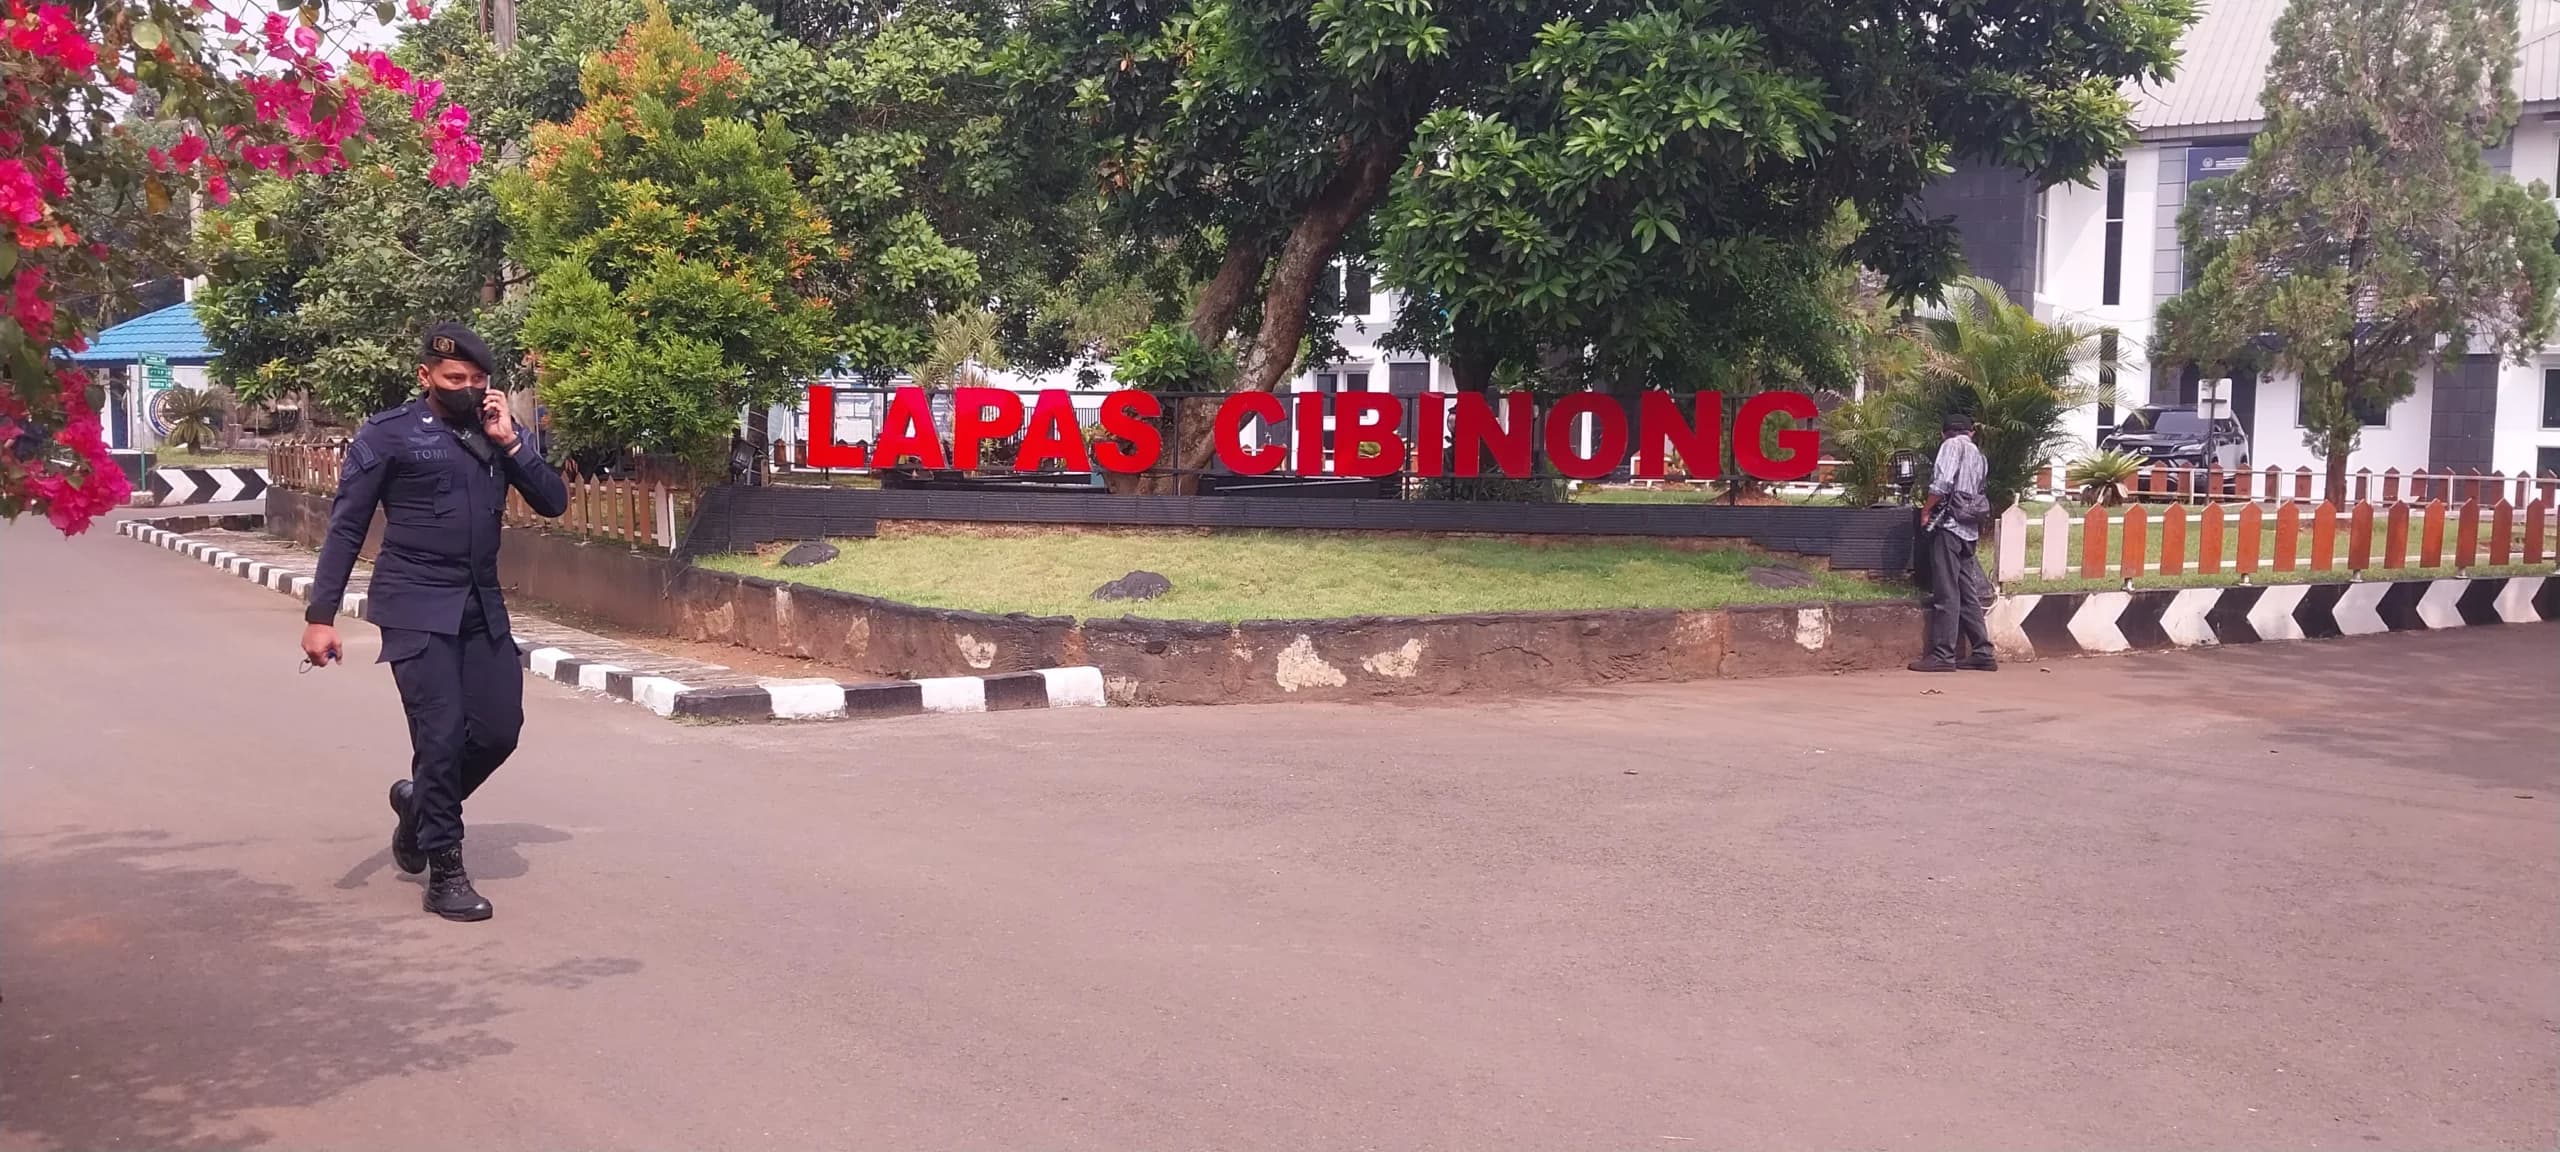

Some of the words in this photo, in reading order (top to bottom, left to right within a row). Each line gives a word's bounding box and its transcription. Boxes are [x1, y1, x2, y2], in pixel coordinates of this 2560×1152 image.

[411, 449, 448, 461] TOMI
[807, 384, 1162, 475] LAPAS
[1214, 390, 1821, 480] CIBINONG
